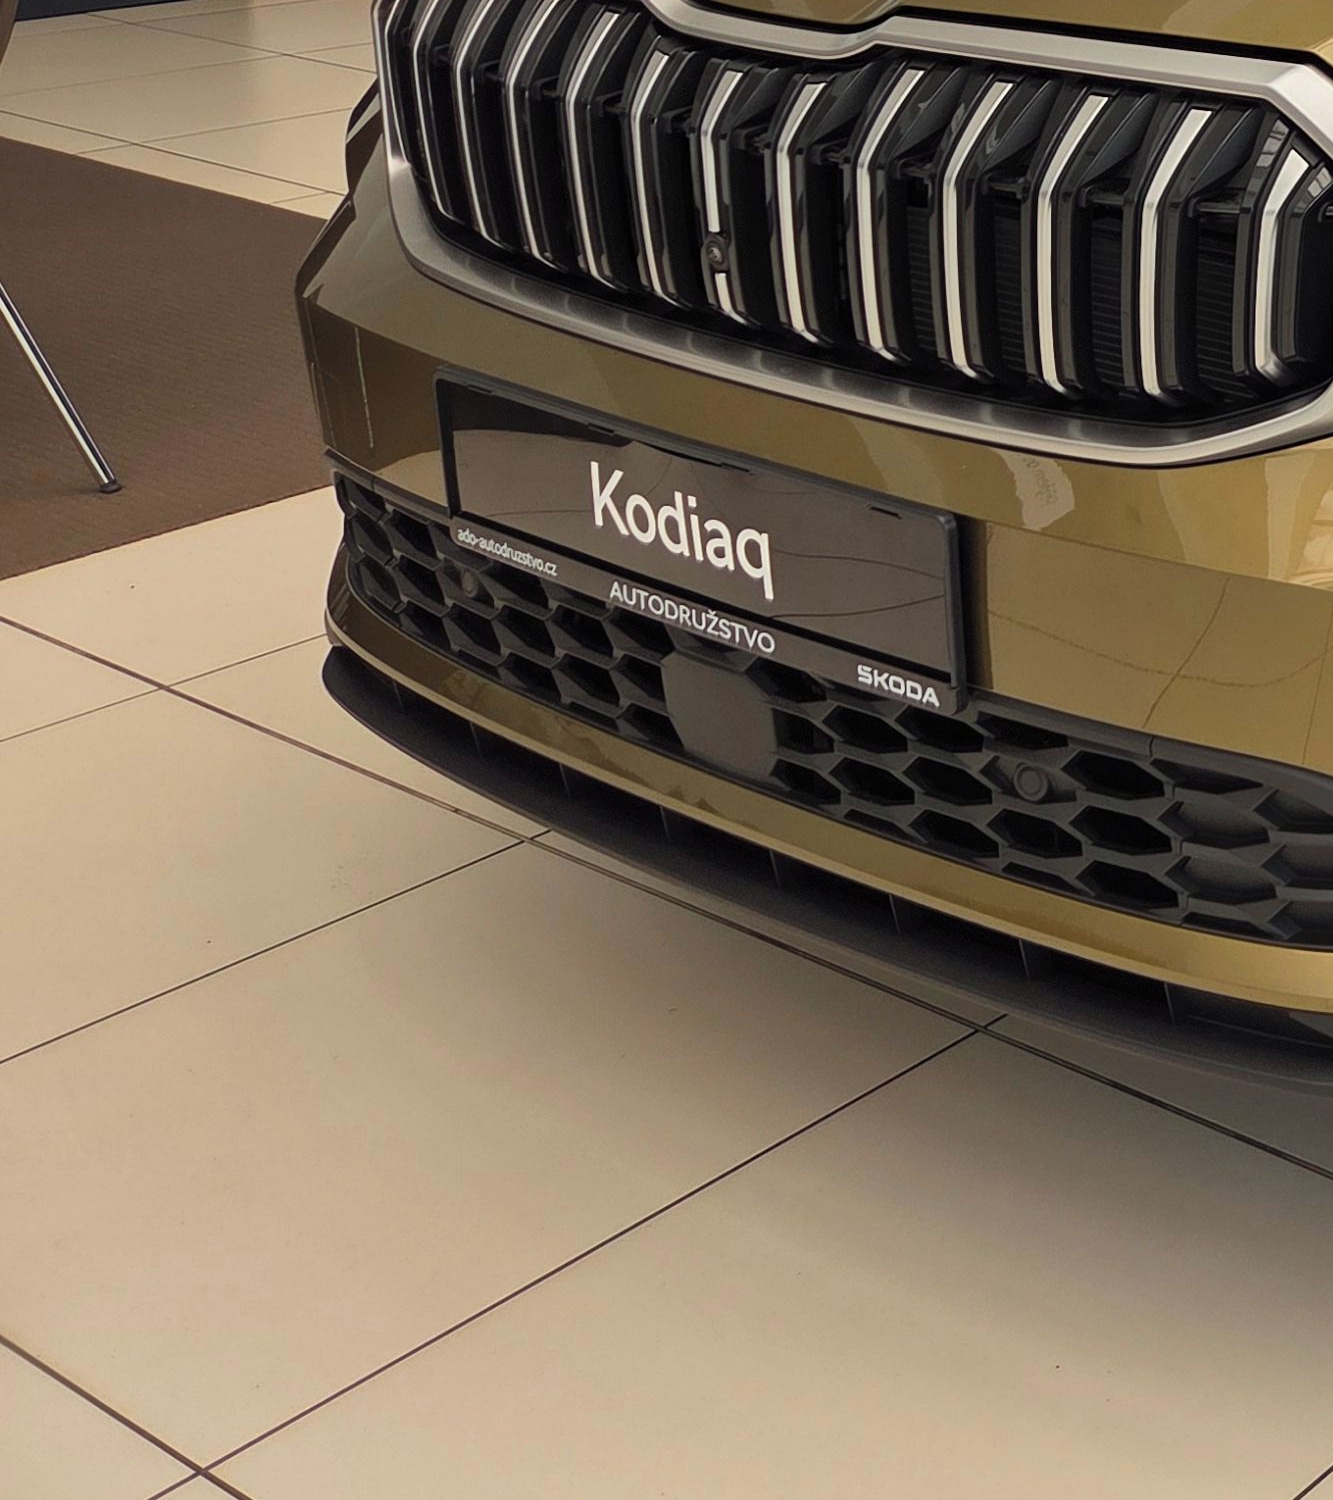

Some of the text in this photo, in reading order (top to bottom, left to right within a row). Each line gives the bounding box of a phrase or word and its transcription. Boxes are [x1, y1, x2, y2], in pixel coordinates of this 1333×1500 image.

[457, 527, 558, 577] ado-autodruzstvo.cz
[589, 460, 775, 601] Kodiaq
[609, 580, 776, 654] AUTODRUŽSTVO
